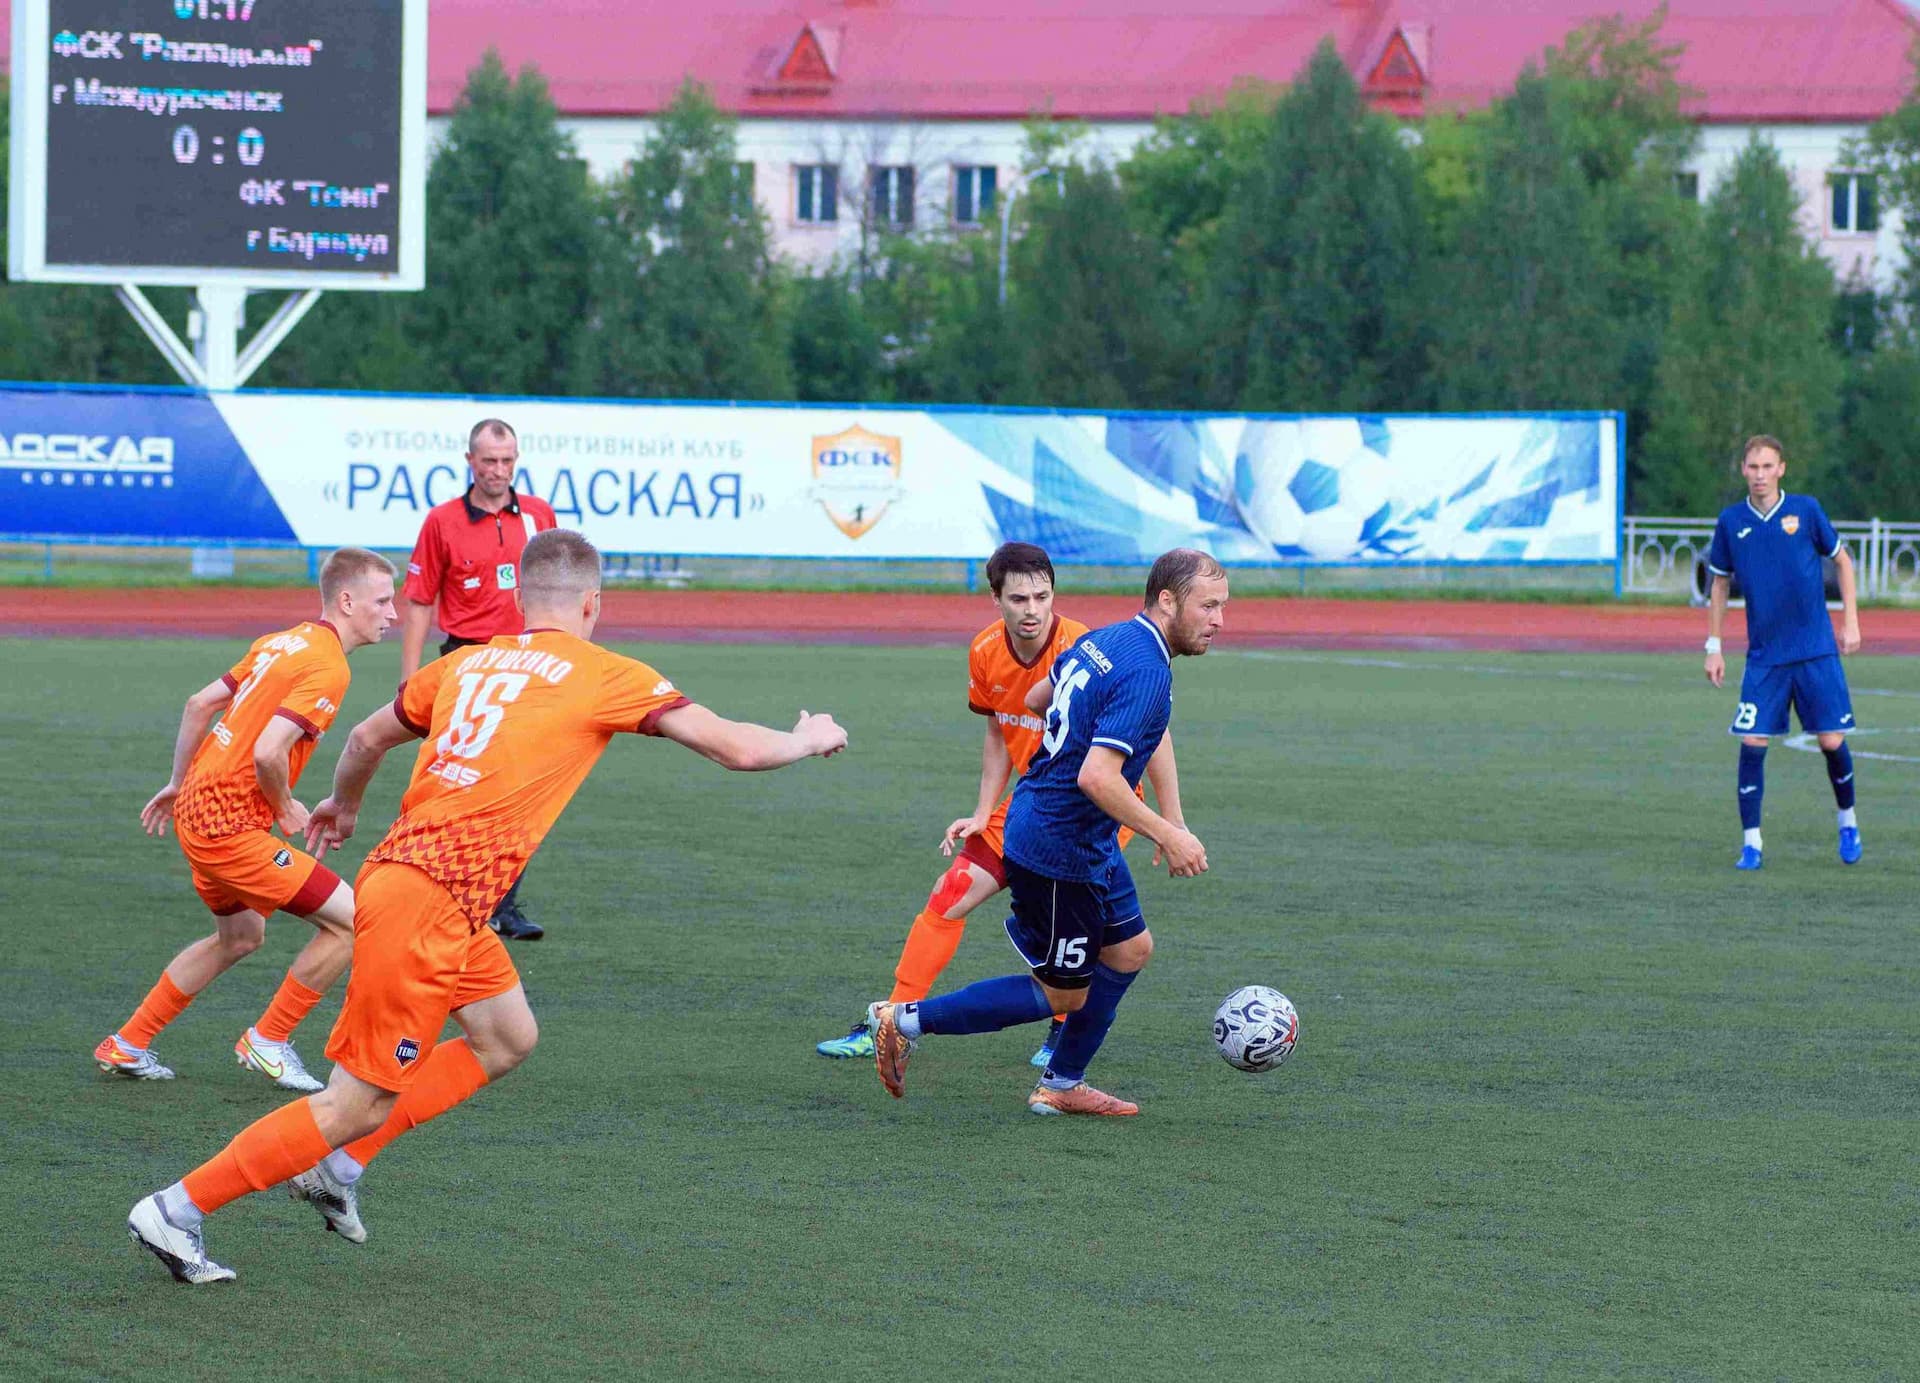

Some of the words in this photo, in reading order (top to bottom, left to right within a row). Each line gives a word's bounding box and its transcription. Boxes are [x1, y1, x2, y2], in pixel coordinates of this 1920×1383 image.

[54, 30, 123, 58] ФСК
[172, 125, 200, 164] 0
[237, 127, 265, 166] 0
[239, 179, 286, 205] ФК
[683, 438, 744, 459] КЛУБ
[323, 462, 766, 525] «РАСАДСКАЯ»
[436, 672, 531, 758] 15
[1734, 702, 1758, 730] 23
[1054, 936, 1088, 969] 15
